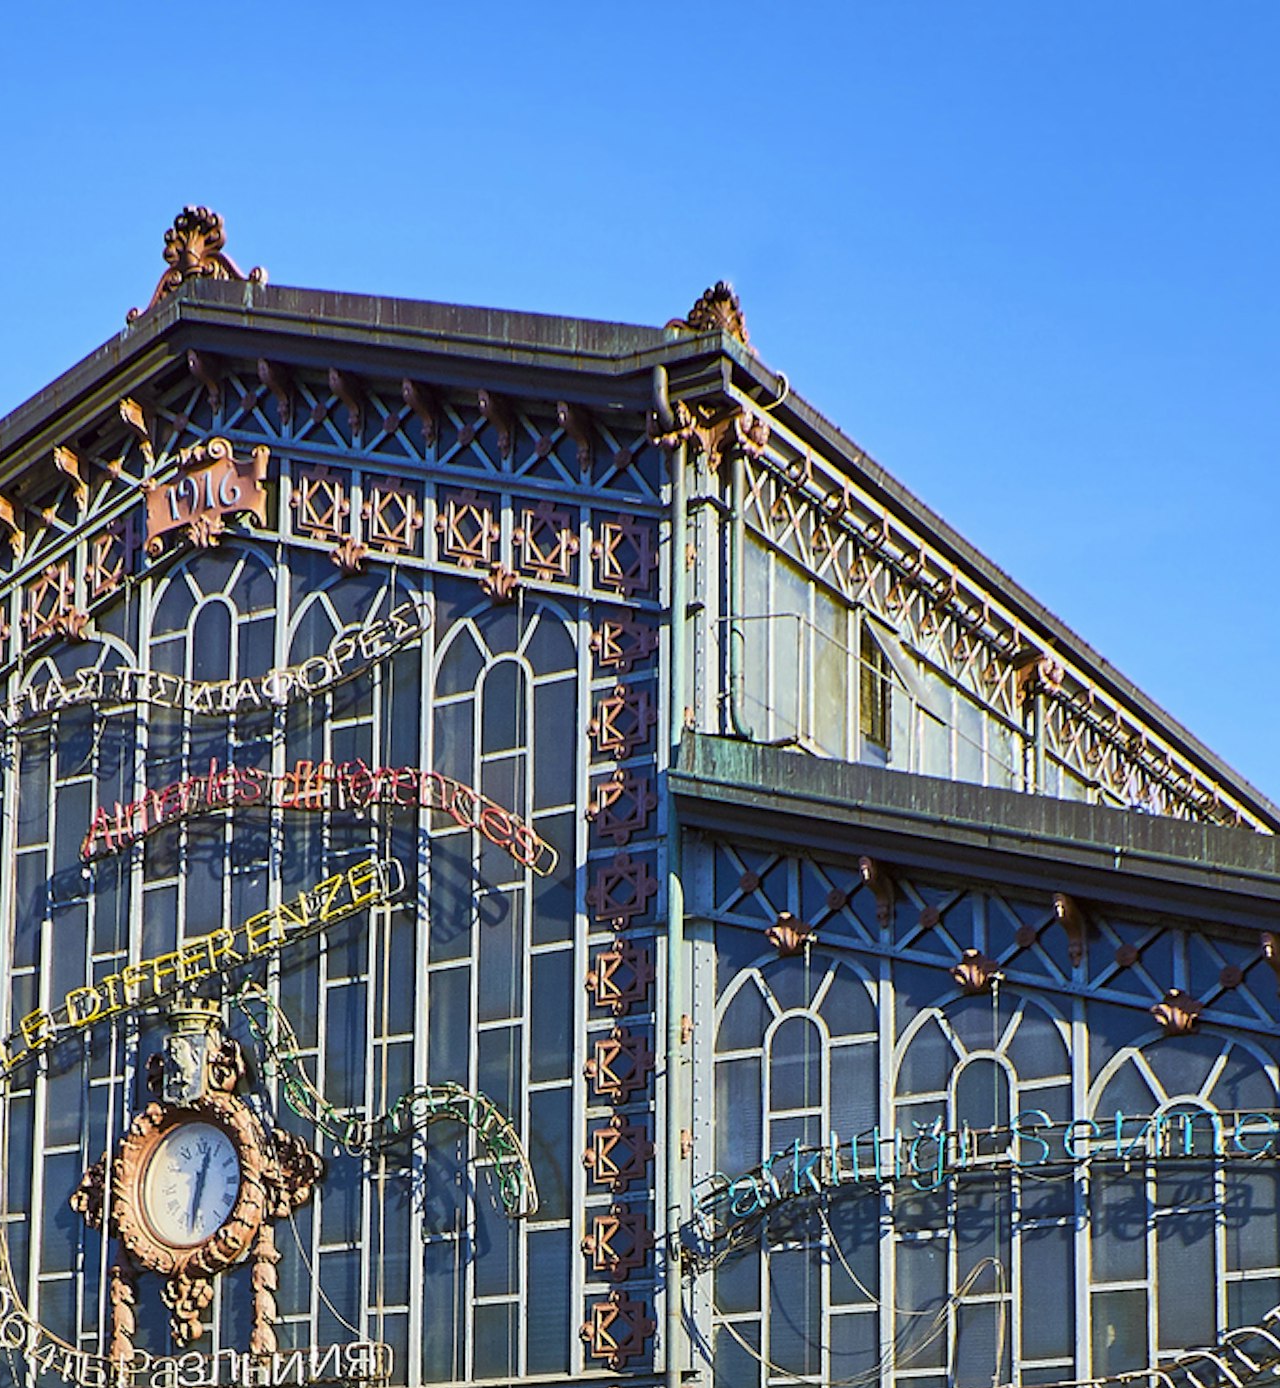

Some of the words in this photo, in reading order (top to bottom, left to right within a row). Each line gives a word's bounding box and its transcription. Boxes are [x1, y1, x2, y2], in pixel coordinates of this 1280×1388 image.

[166, 470, 241, 521] 1916
[208, 757, 263, 806] les
[65, 858, 381, 1027] DIFFERENZE
